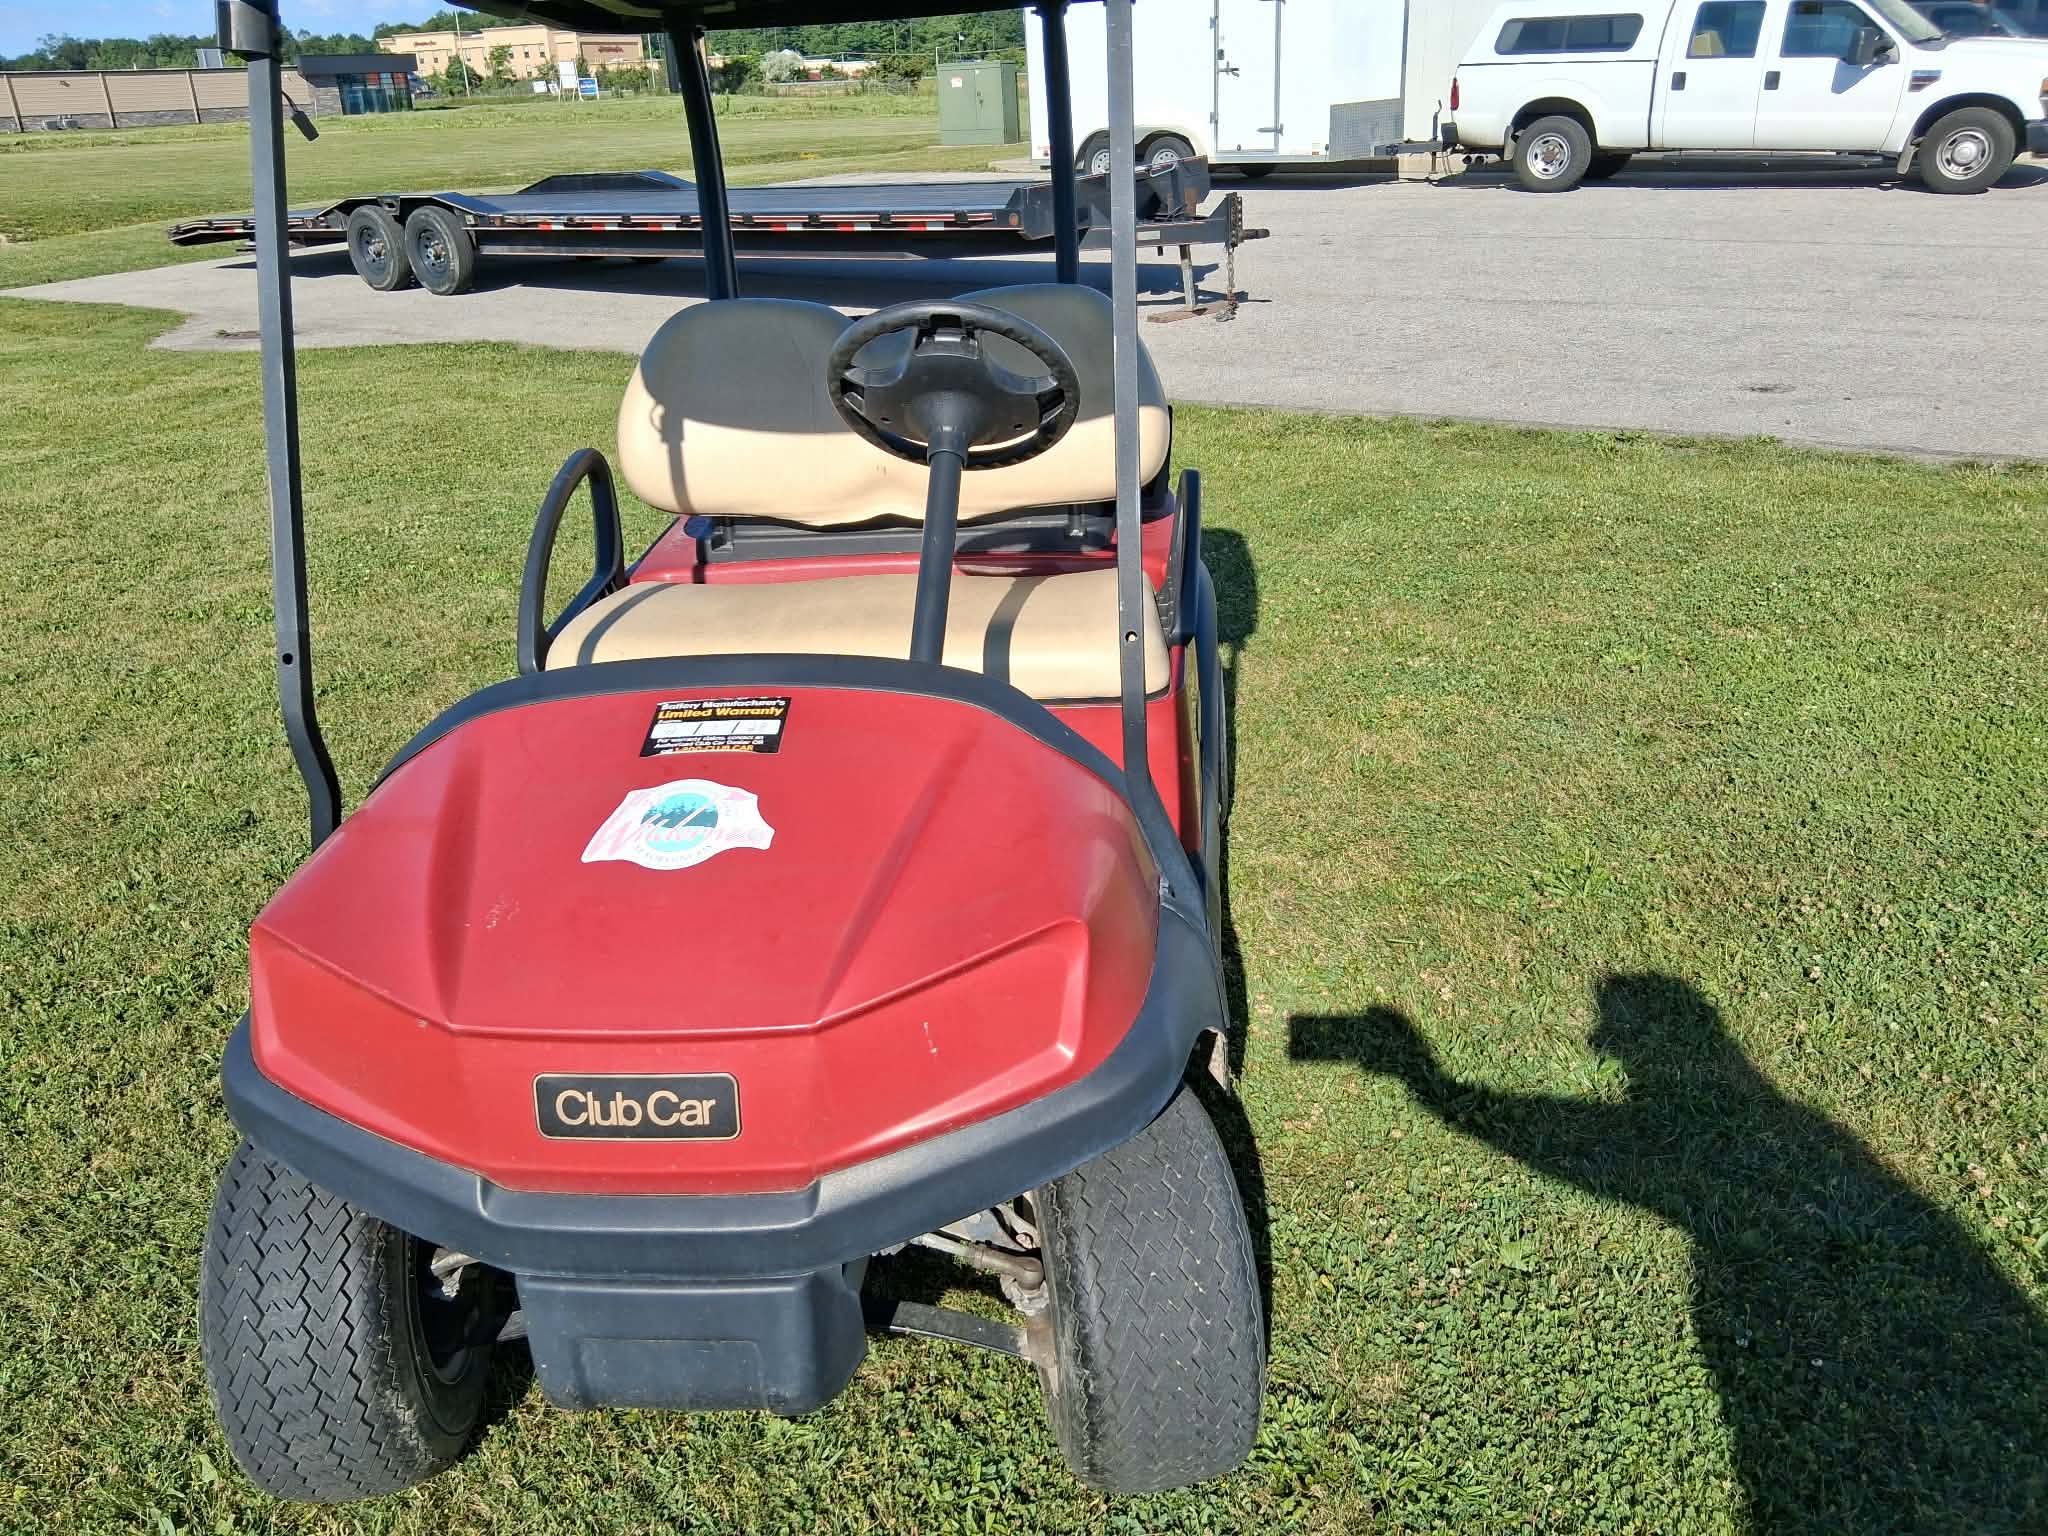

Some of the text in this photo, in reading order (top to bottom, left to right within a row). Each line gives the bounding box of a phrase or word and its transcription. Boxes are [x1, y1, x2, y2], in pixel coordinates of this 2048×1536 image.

[661, 700, 786, 711] Battery Manufacturer's
[657, 707, 785, 719] Limited Warranty
[555, 1089, 717, 1127] Club Car
